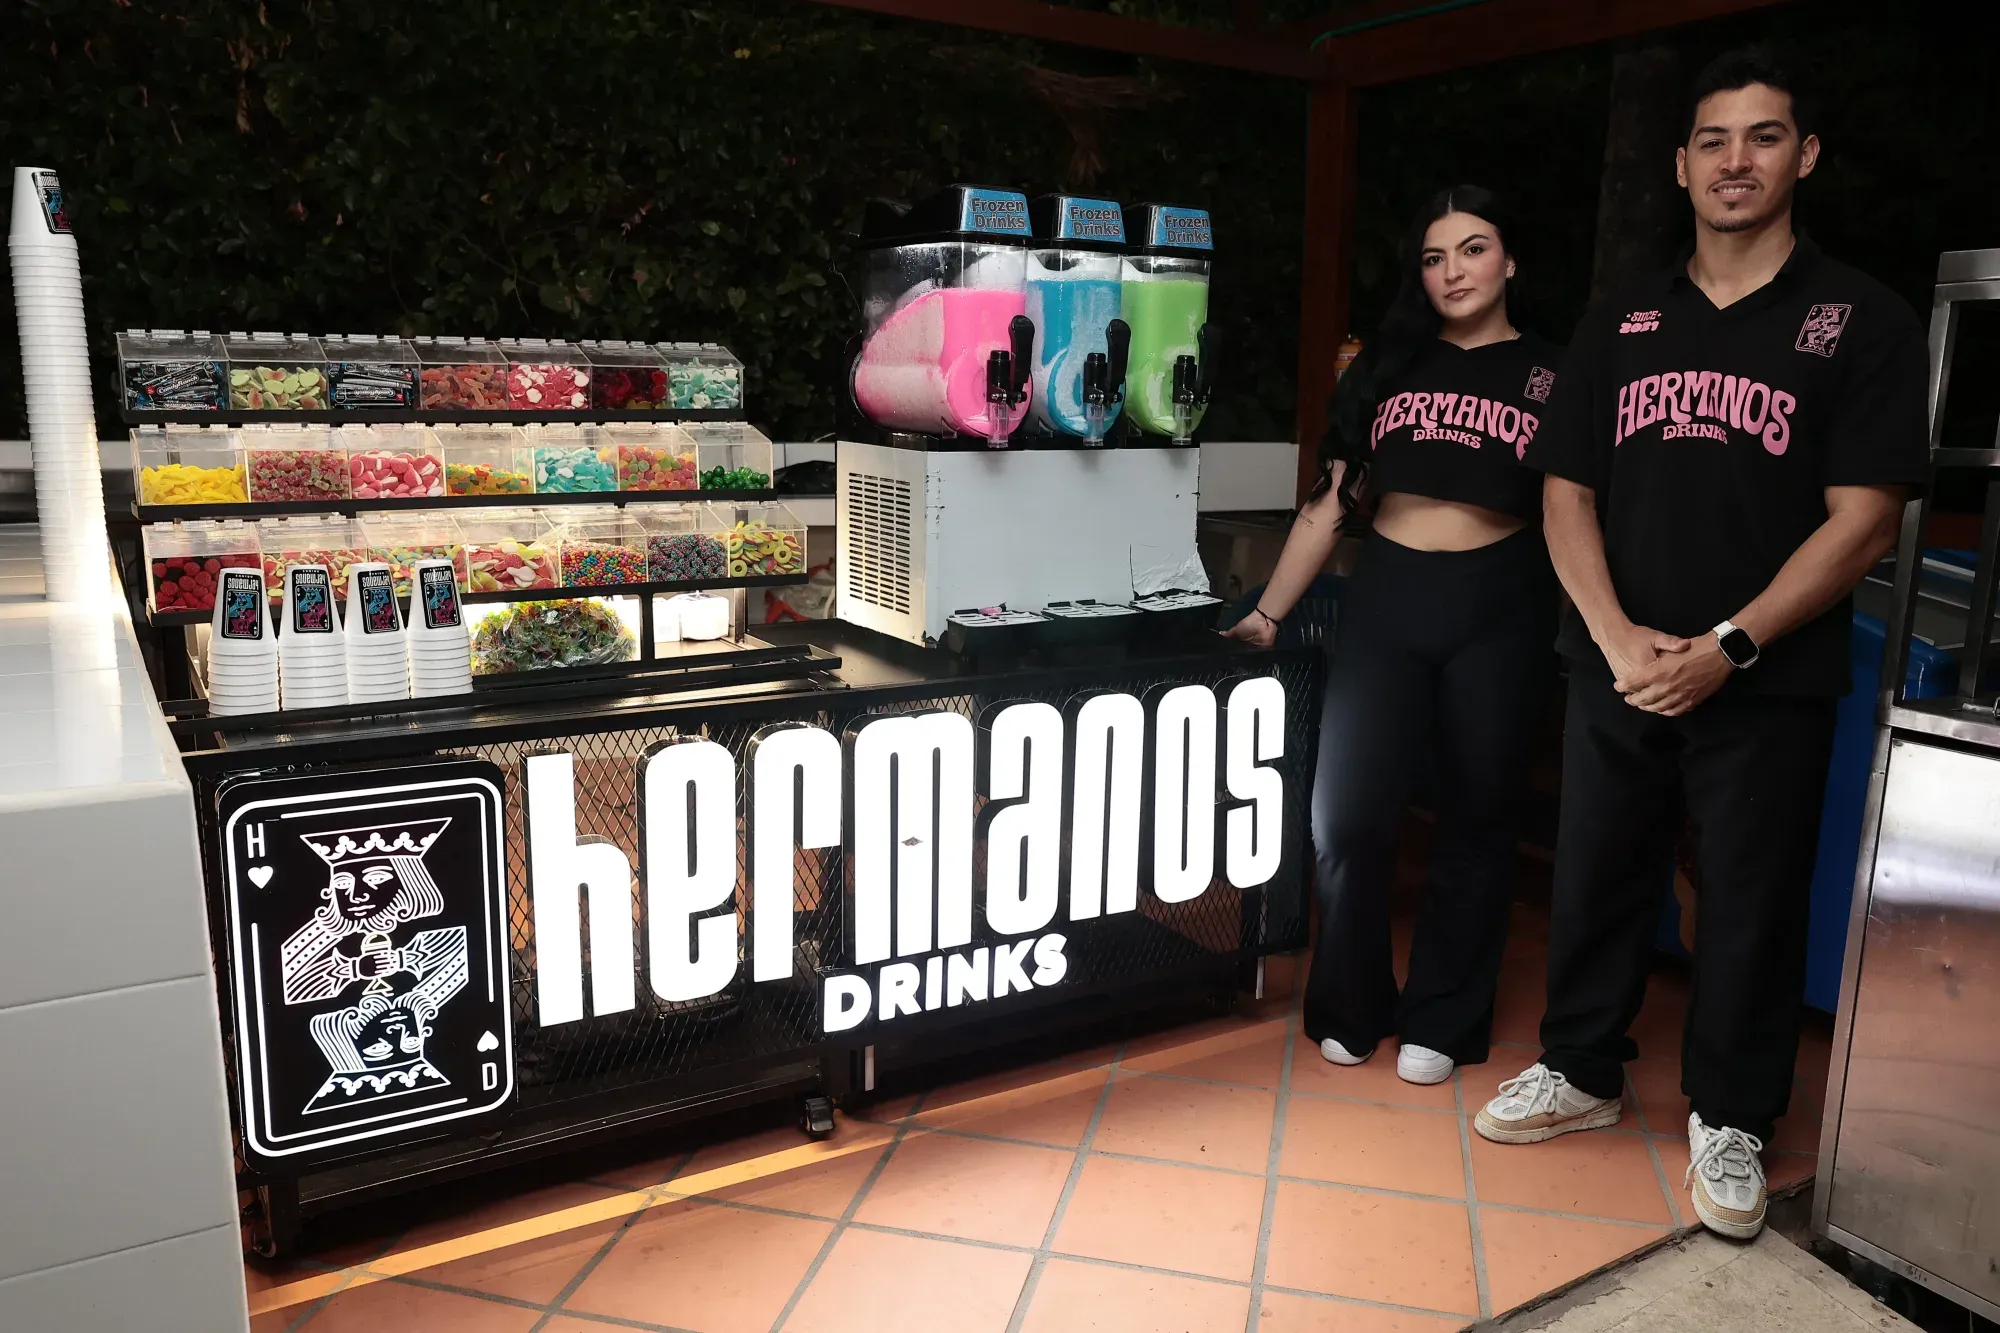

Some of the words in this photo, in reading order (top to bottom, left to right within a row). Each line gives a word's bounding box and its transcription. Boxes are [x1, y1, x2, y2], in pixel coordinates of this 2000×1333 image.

[970, 197, 1024, 213] Frozen
[1069, 206, 1120, 221] Frozen
[974, 213, 1026, 229] Drinks
[1072, 221, 1120, 237] Drinks
[1163, 214, 1210, 229] Frozen
[1166, 229, 1210, 244] Drinks
[1630, 310, 1659, 322] SINCE
[1619, 321, 1660, 334] 2021
[1614, 370, 1796, 456] HERMANOS
[1370, 391, 1540, 462] HERMANOS
[1662, 422, 1728, 446] DRINKS
[1412, 428, 1482, 450] DRINKS
[246, 823, 266, 859] H
[526, 675, 1287, 1028] hermanos
[822, 932, 1068, 1034] DRINKS
[482, 1062, 498, 1092] D
